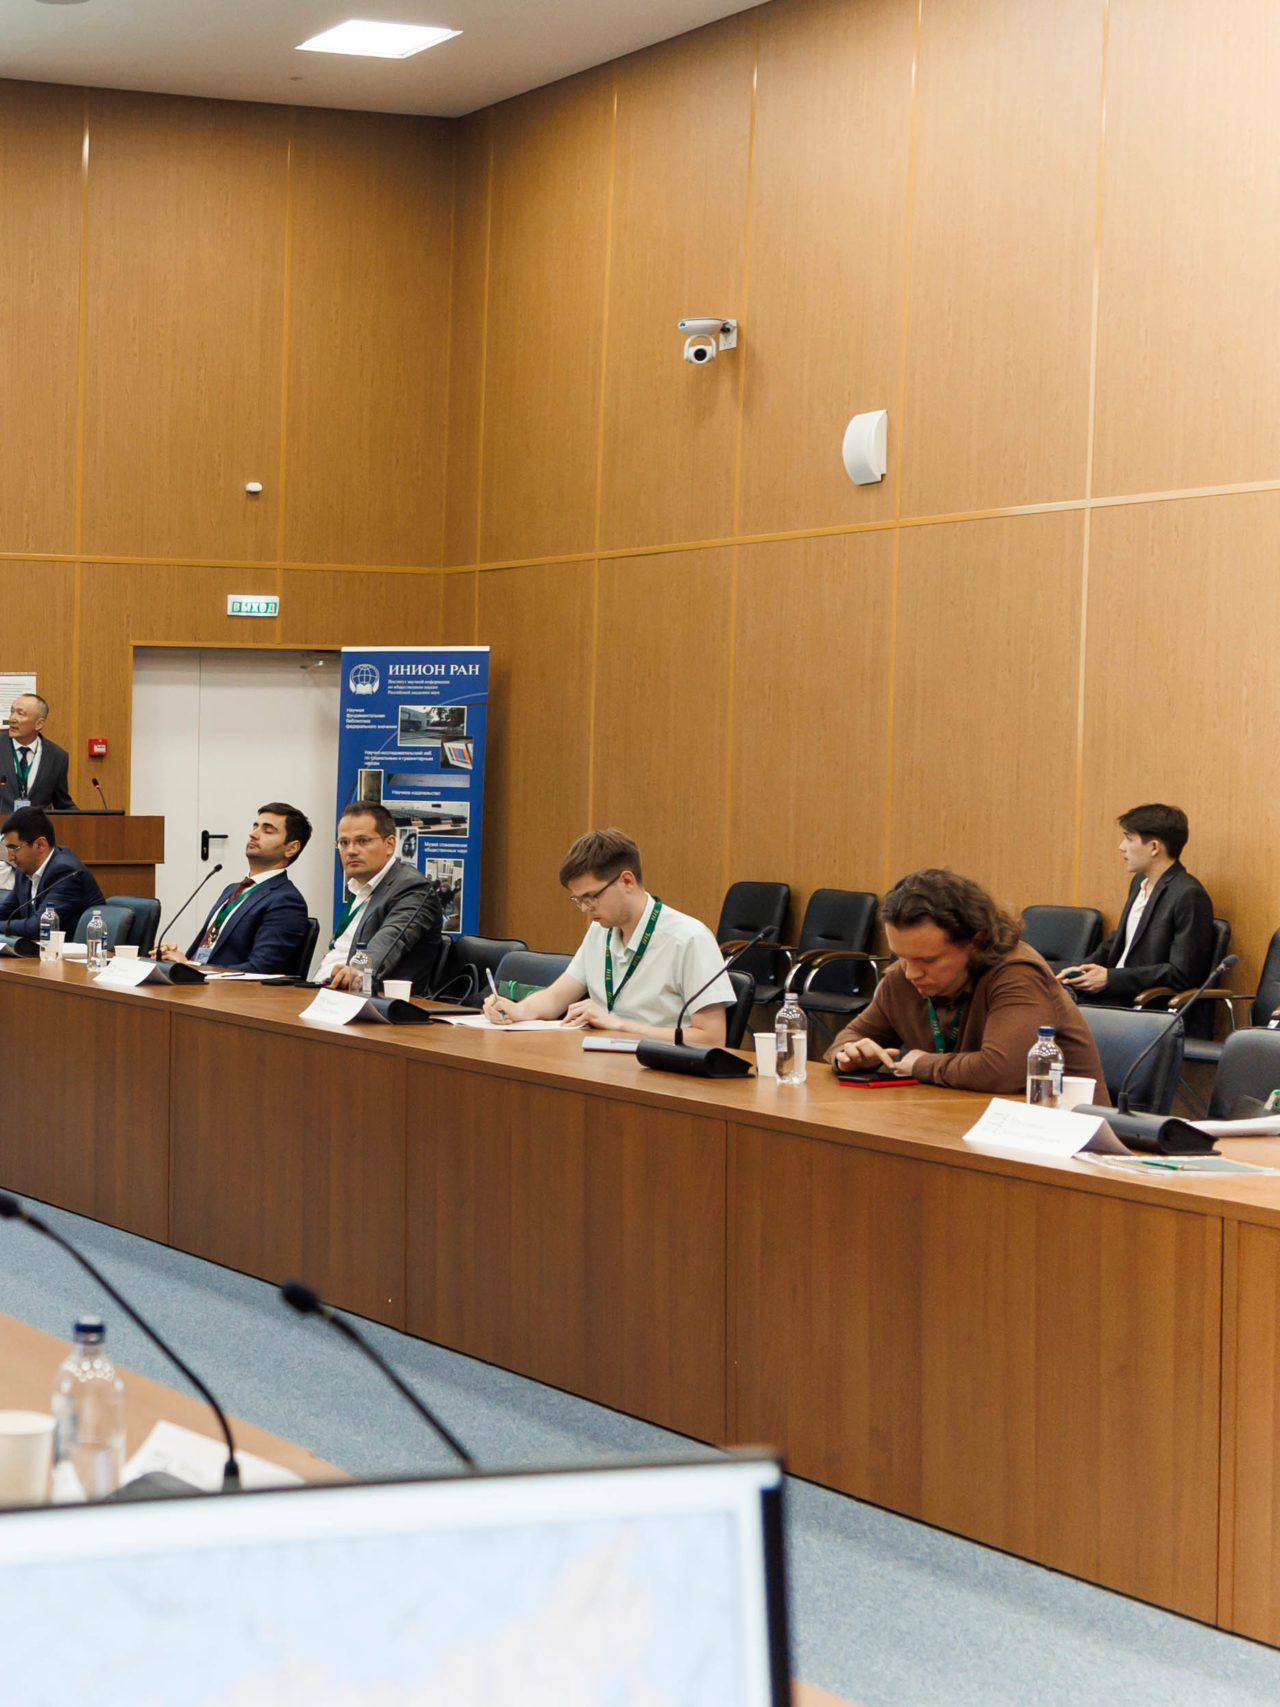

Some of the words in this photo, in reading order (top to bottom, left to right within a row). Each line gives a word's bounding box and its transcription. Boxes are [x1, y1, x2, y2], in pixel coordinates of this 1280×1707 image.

[232, 601, 277, 613] ВЫХОД
[388, 664, 446, 676] ИНИОН
[449, 664, 480, 676] РАН
